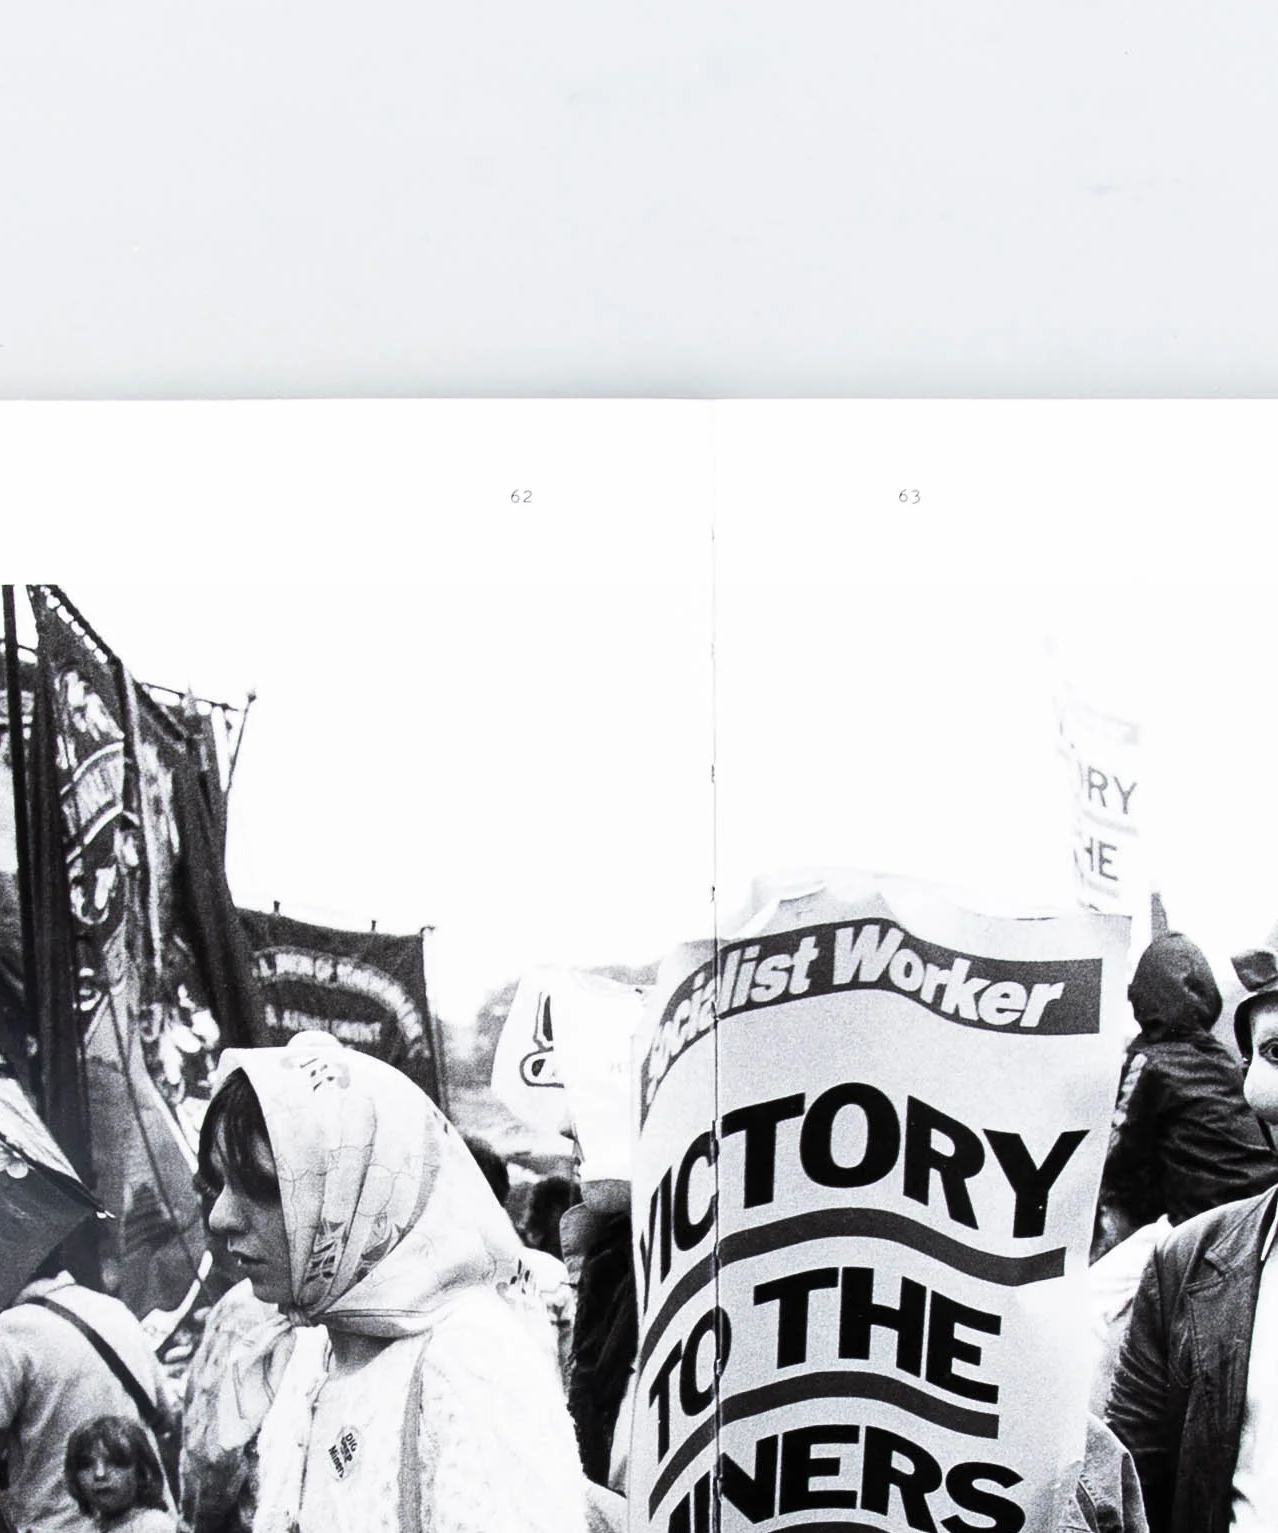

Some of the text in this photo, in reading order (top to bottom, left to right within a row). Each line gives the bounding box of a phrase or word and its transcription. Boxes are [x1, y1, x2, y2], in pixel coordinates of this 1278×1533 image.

[510, 489, 533, 503] 62
[898, 489, 922, 504] 63
[832, 924, 1065, 1027] Worker
[640, 1082, 1090, 1314] VICTORY
[649, 1267, 1002, 1464] TO THE
[345, 1432, 358, 1452] DIG
